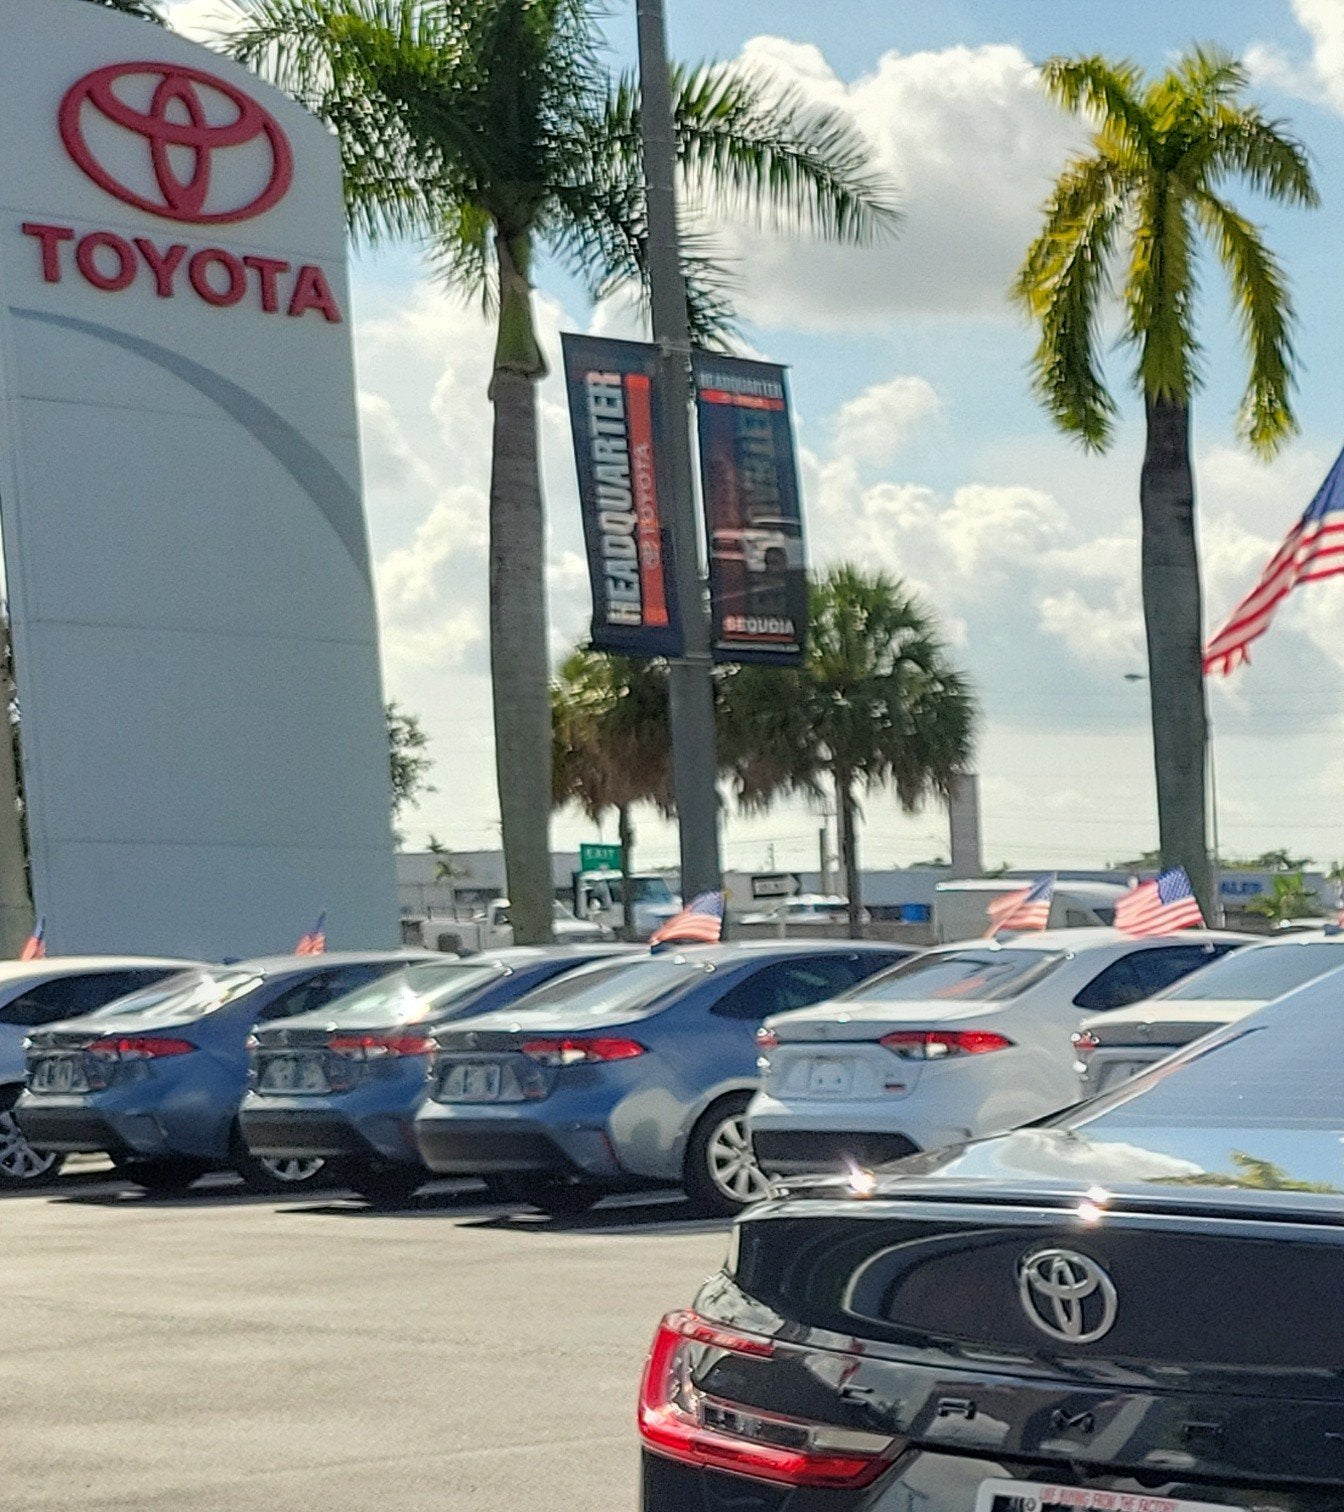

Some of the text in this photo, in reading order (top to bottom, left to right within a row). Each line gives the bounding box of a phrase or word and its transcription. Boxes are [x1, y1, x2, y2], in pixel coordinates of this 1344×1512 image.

[22, 222, 342, 323] TOYOTA
[586, 370, 642, 626] HEADQUARTER
[632, 442, 657, 535] TOYOTA
[722, 614, 795, 636] SEQUOIA
[1093, 1493, 1117, 1508] FROM
[1120, 1496, 1136, 1510] THE
